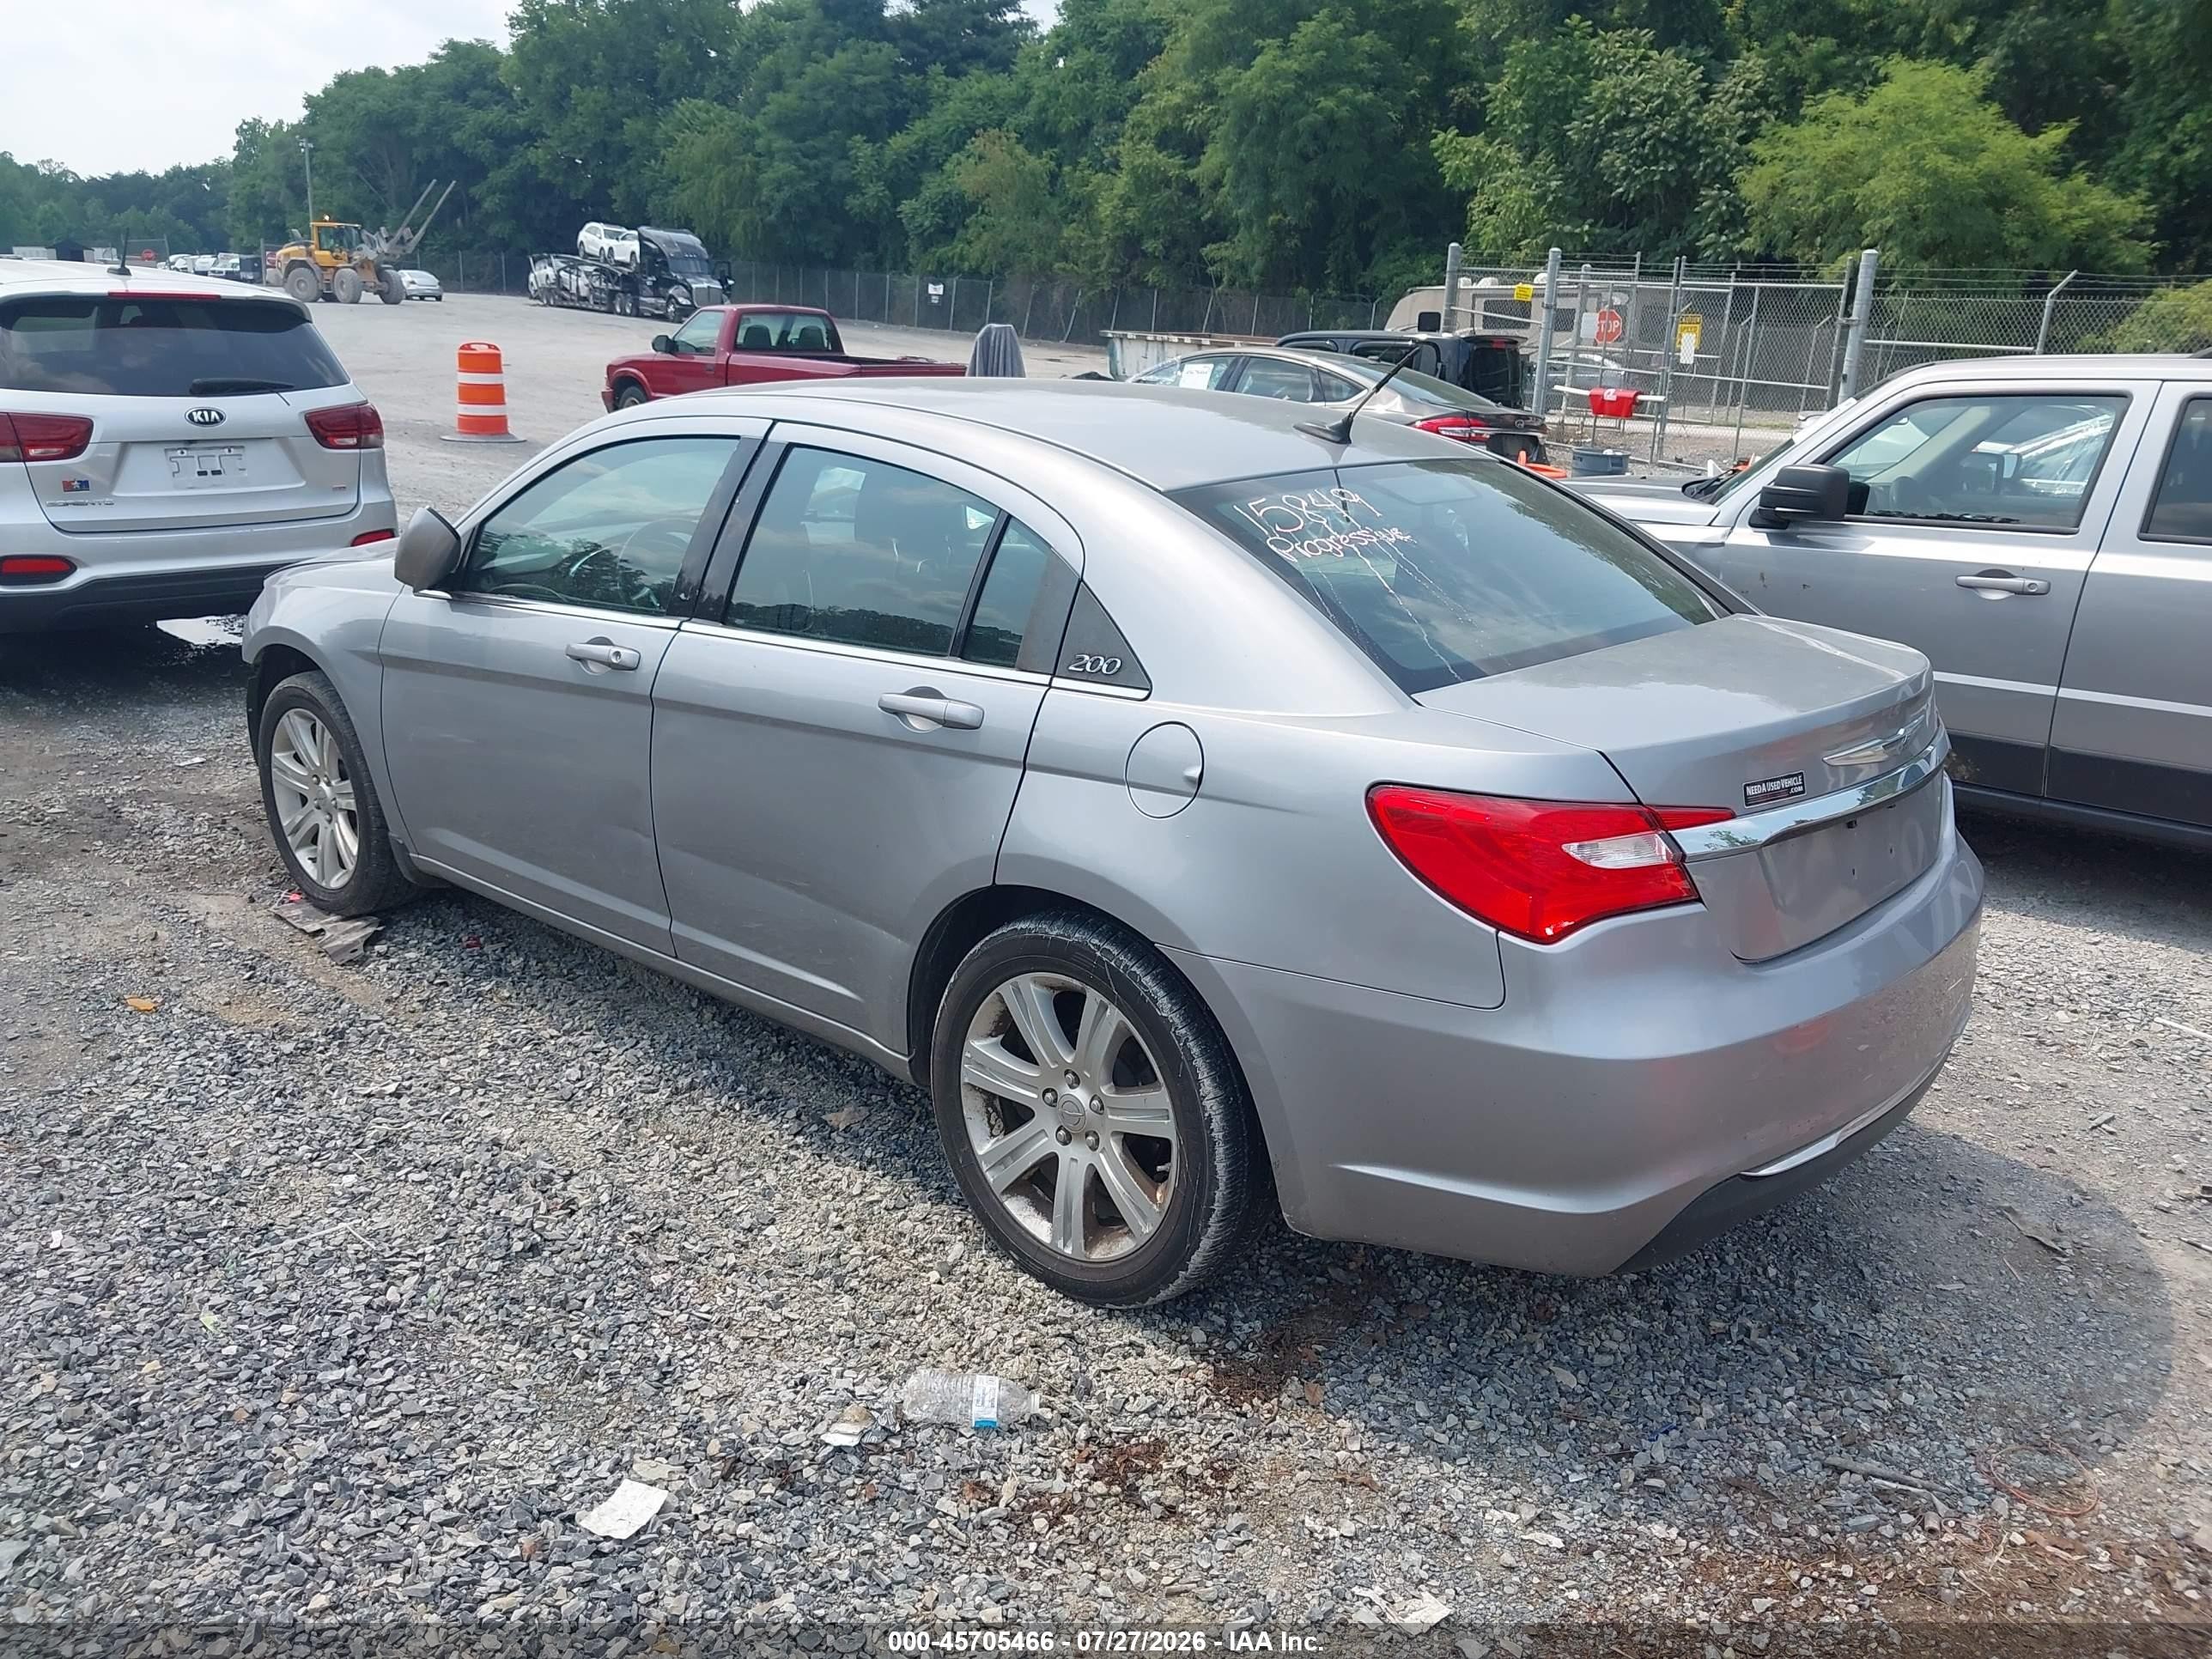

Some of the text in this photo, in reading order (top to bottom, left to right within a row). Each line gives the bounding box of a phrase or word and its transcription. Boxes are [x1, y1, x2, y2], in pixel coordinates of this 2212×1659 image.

[1598, 320, 1620, 331] TOP
[191, 410, 222, 422] KIA
[1233, 489, 1382, 537] 15849
[1068, 654, 1121, 675] 200
[1746, 775, 1802, 796] NEED A USED VEHICLE
